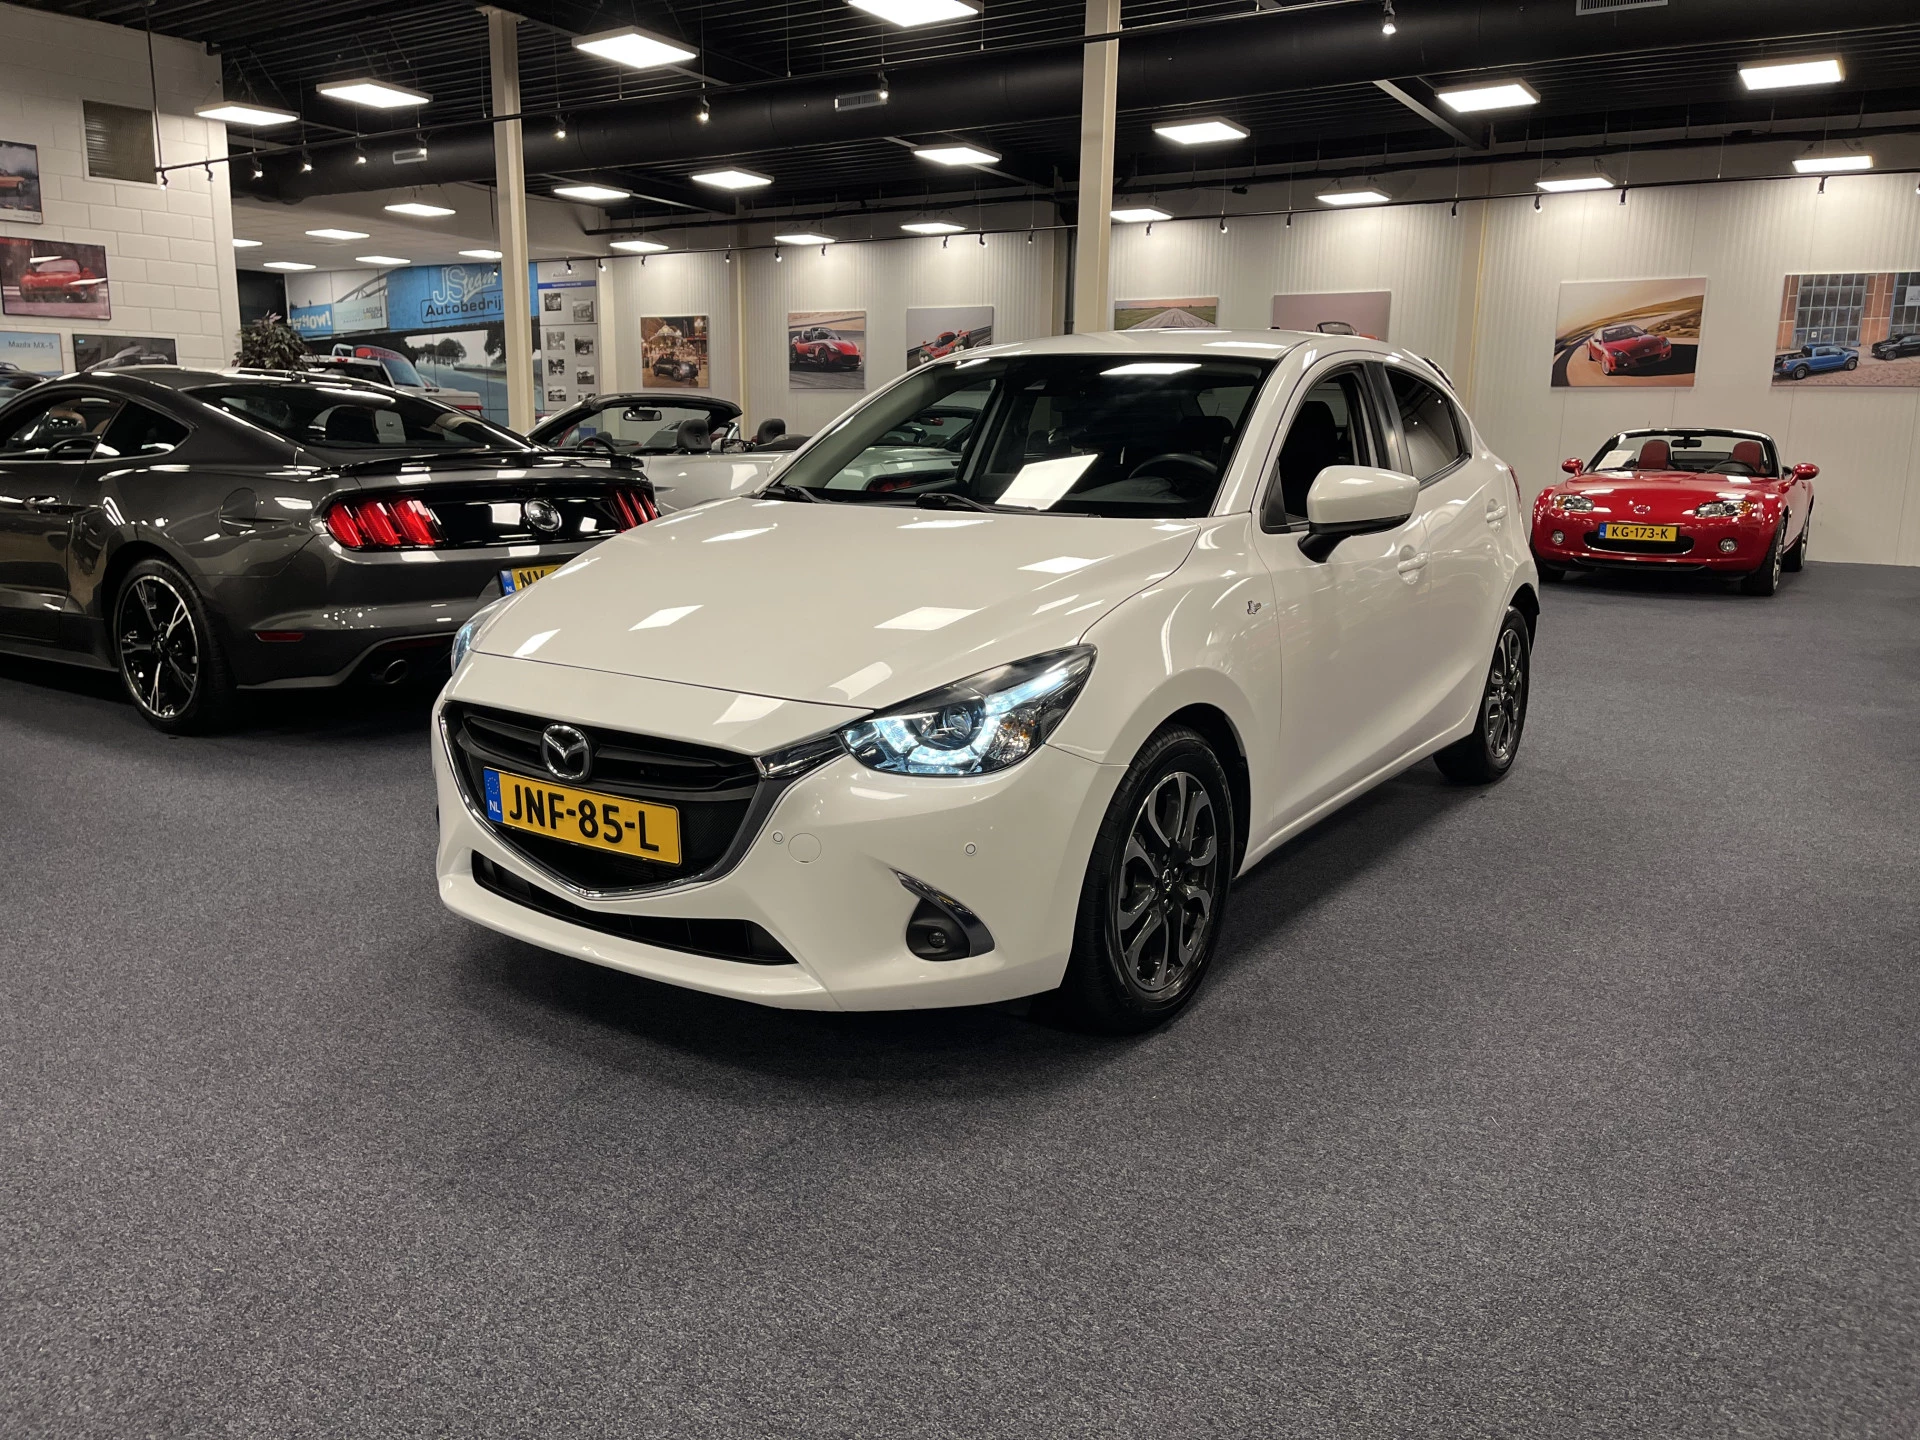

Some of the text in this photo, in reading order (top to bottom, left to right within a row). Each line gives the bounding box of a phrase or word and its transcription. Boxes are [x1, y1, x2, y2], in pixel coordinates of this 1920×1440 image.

[426, 295, 503, 317] Autobedrij
[8, 340, 31, 348] Mazda
[1612, 526, 1668, 539] KG-173-K
[505, 585, 515, 593] NL
[489, 800, 501, 813] NL
[509, 784, 660, 852] JNF-85-L
